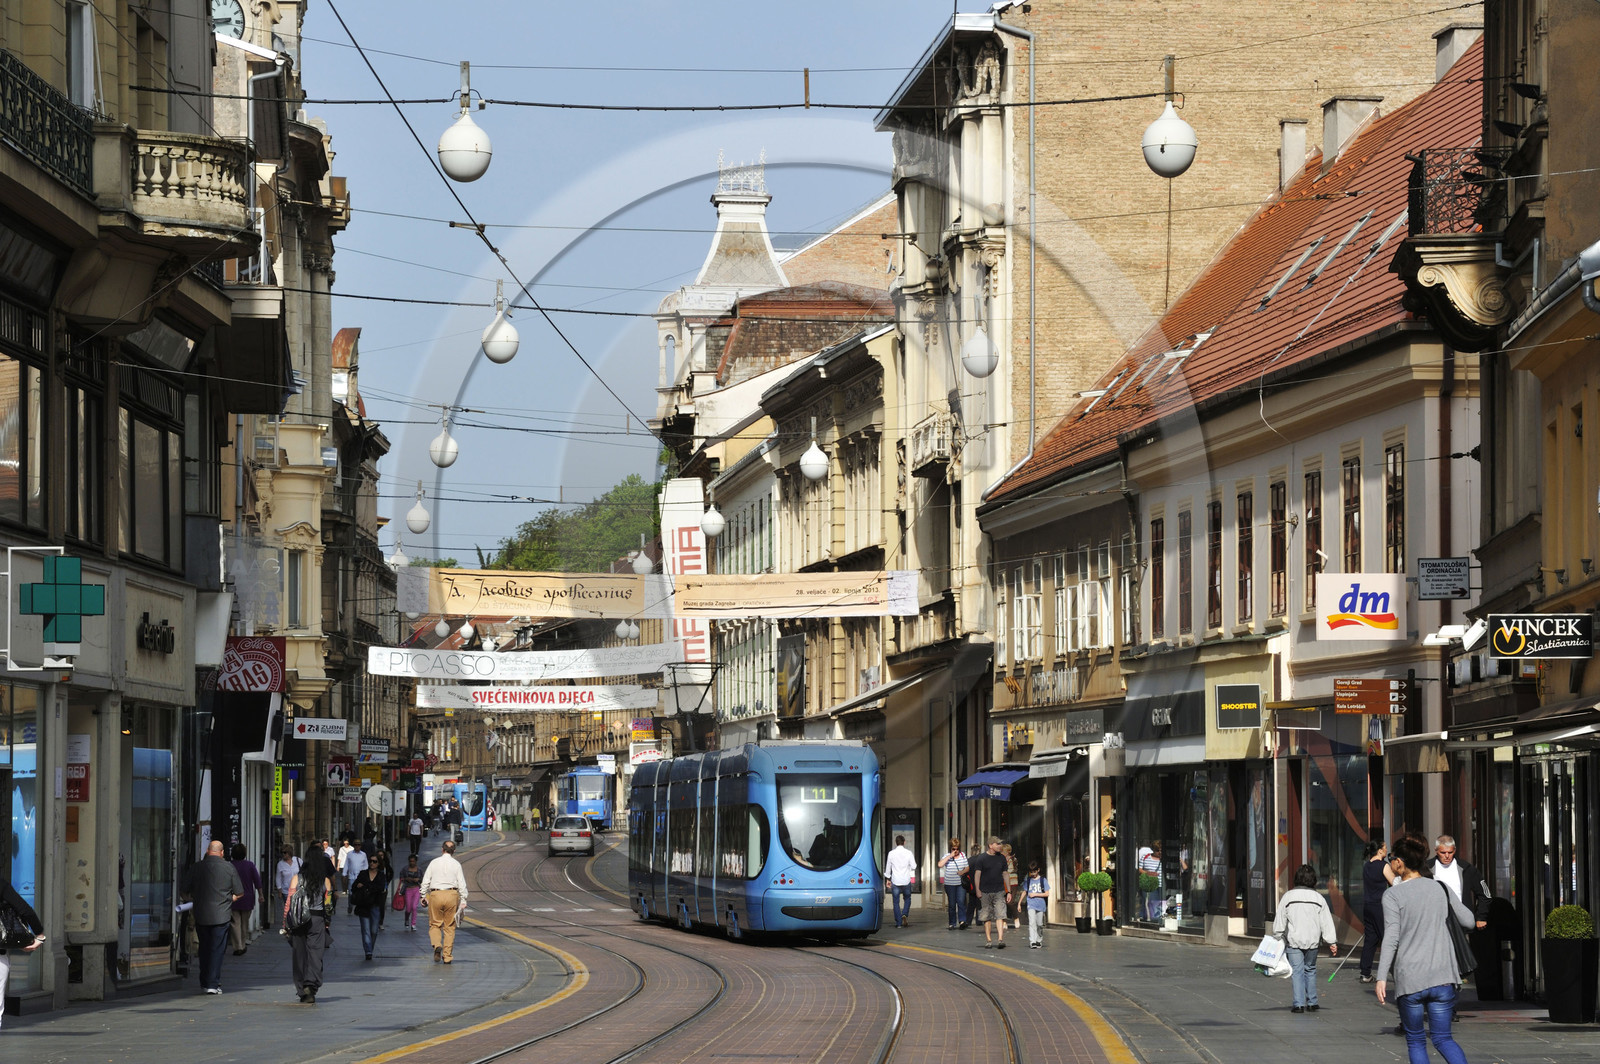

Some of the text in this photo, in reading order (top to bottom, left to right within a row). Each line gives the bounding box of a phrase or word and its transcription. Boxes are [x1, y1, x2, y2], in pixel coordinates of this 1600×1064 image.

[468, 577, 533, 614] Jacobus
[543, 582, 633, 613] apothecarius
[1339, 583, 1390, 613] dm
[1500, 618, 1582, 637] VINCEK
[1524, 638, 1590, 656] Slastičarnica
[390, 652, 496, 676] PICASSO
[472, 688, 555, 704] SVEĆENIKOVA
[558, 690, 595, 704] DJECA
[812, 787, 826, 800] 11
